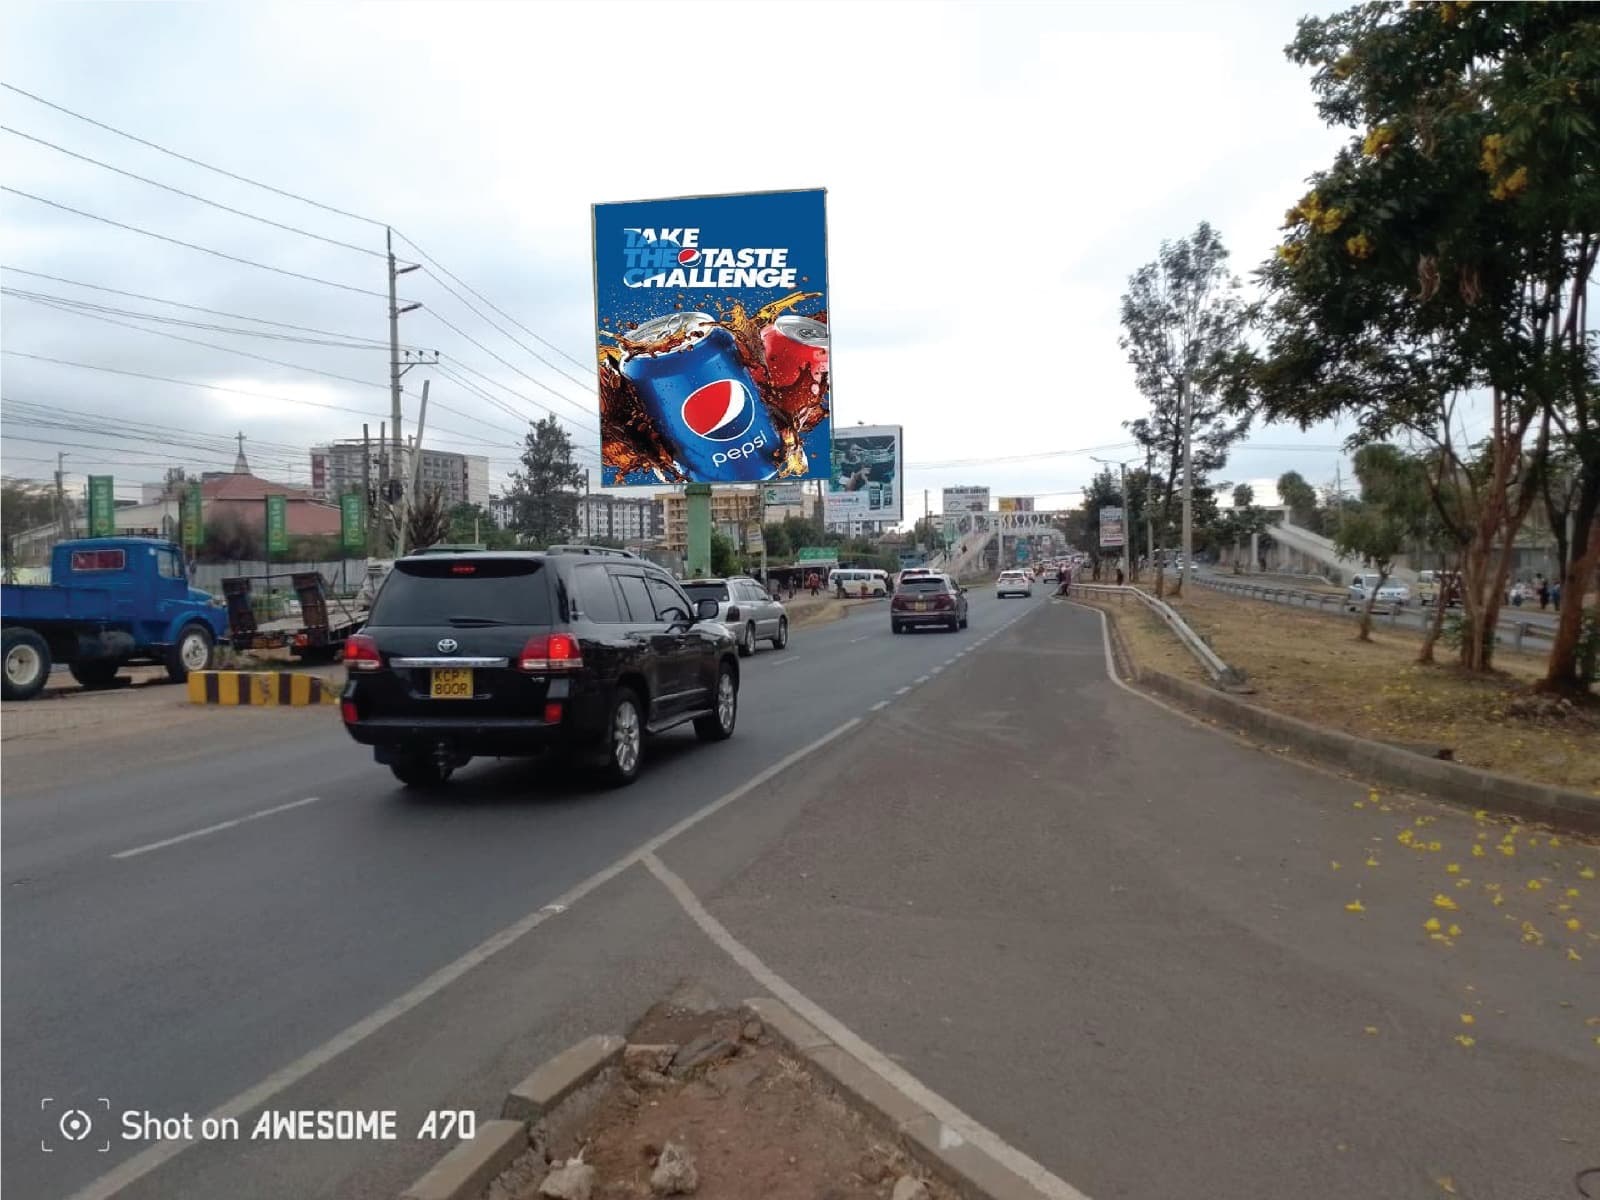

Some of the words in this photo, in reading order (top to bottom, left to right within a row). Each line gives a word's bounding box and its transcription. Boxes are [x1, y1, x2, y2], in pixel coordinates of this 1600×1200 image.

[623, 228, 700, 248] TAKE
[623, 248, 679, 268] THE
[701, 248, 789, 268] TASTE
[623, 268, 798, 288] CHALLENGE
[712, 430, 768, 468] pepsi
[434, 671, 460, 682] KCP
